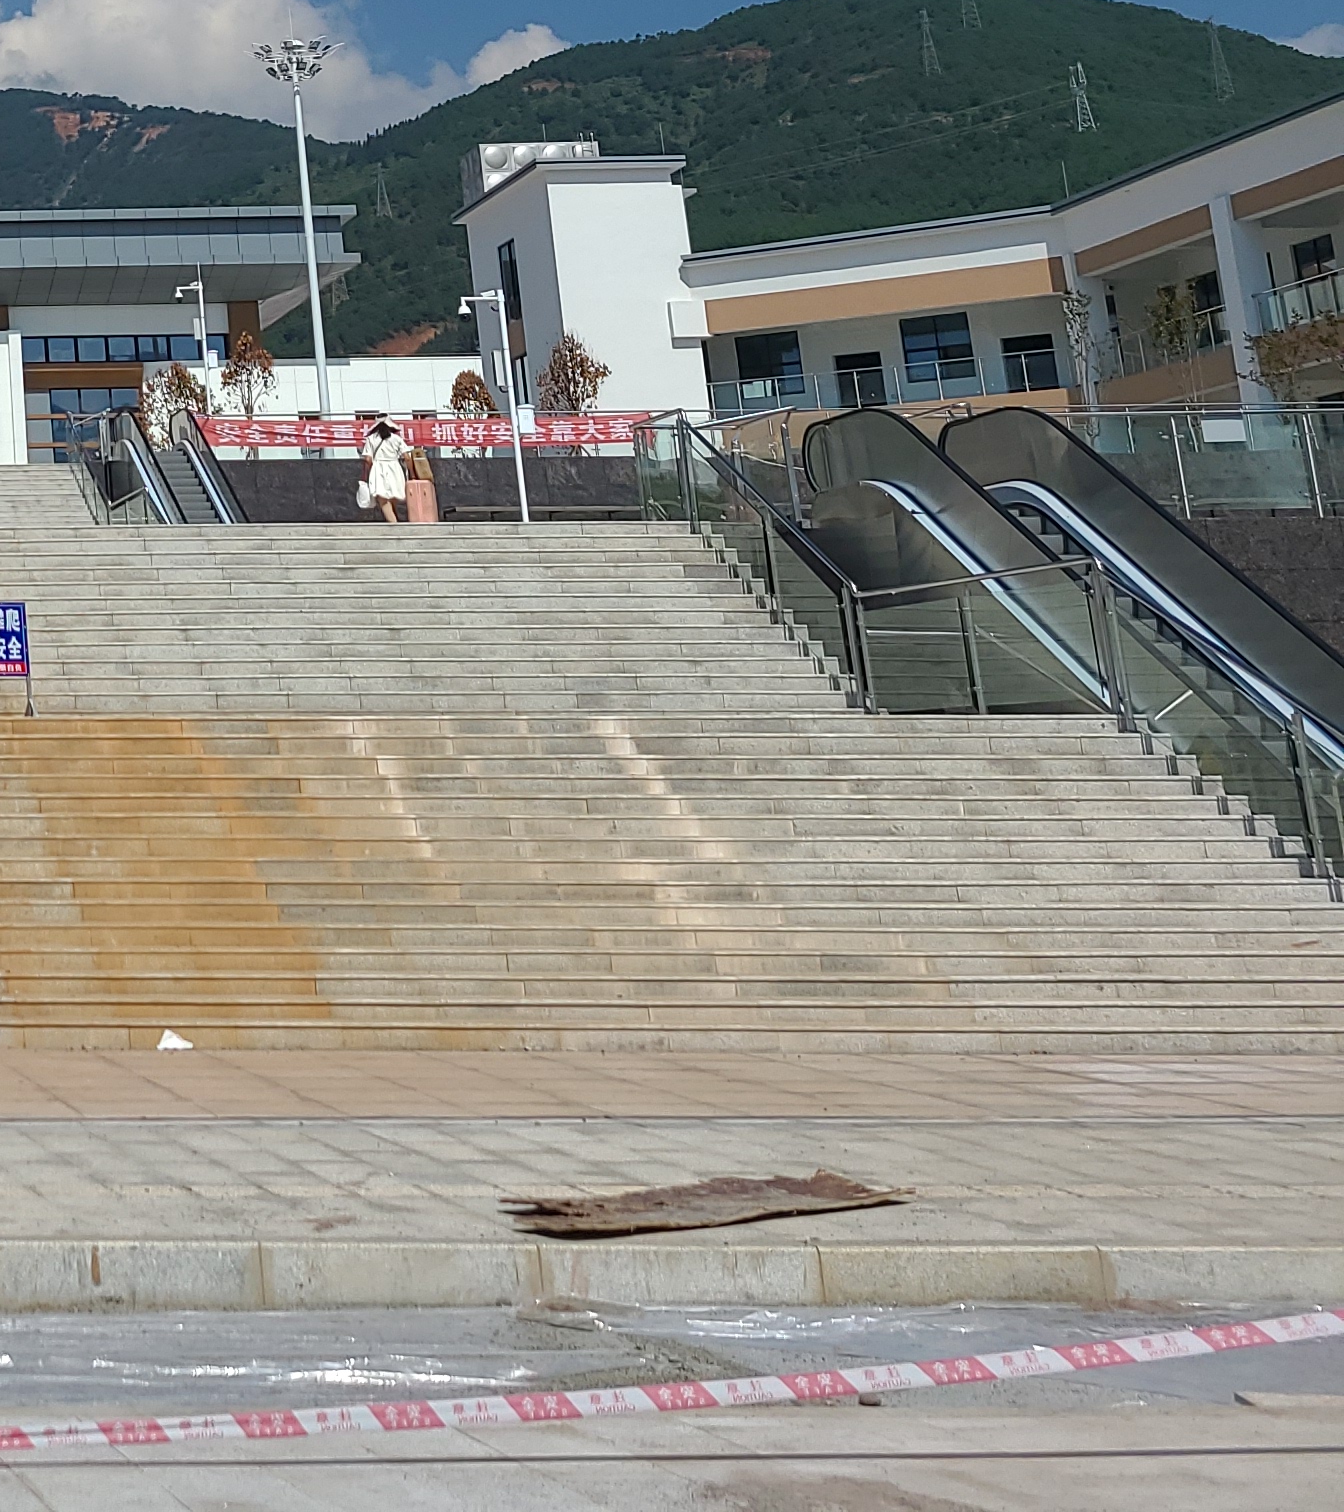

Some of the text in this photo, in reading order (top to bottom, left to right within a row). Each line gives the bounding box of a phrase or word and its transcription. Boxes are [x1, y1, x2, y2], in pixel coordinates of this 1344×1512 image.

[215, 419, 634, 445] 安全责任重山 抓好安全靠大家
